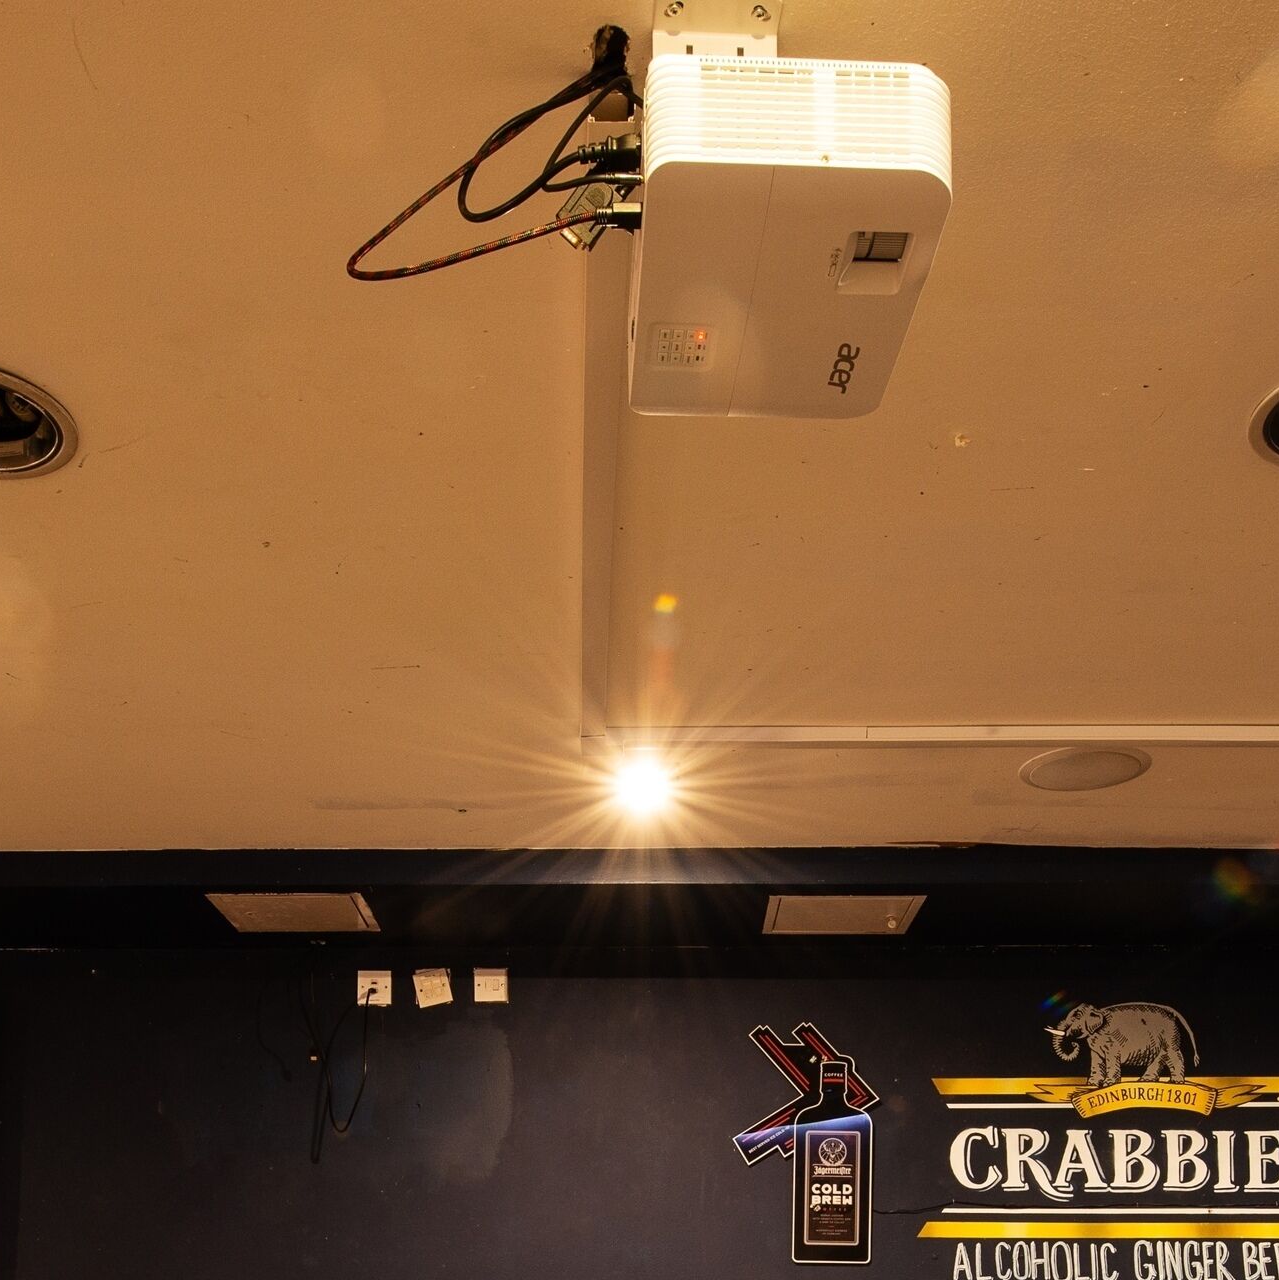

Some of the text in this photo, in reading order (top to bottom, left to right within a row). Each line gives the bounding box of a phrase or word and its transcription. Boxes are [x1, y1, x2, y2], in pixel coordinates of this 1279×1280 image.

[828, 343, 860, 394] acer
[1087, 1087, 1198, 1109] EDINBURGH 1801
[812, 1183, 852, 1195] COLD
[811, 1195, 852, 1206] BREW
